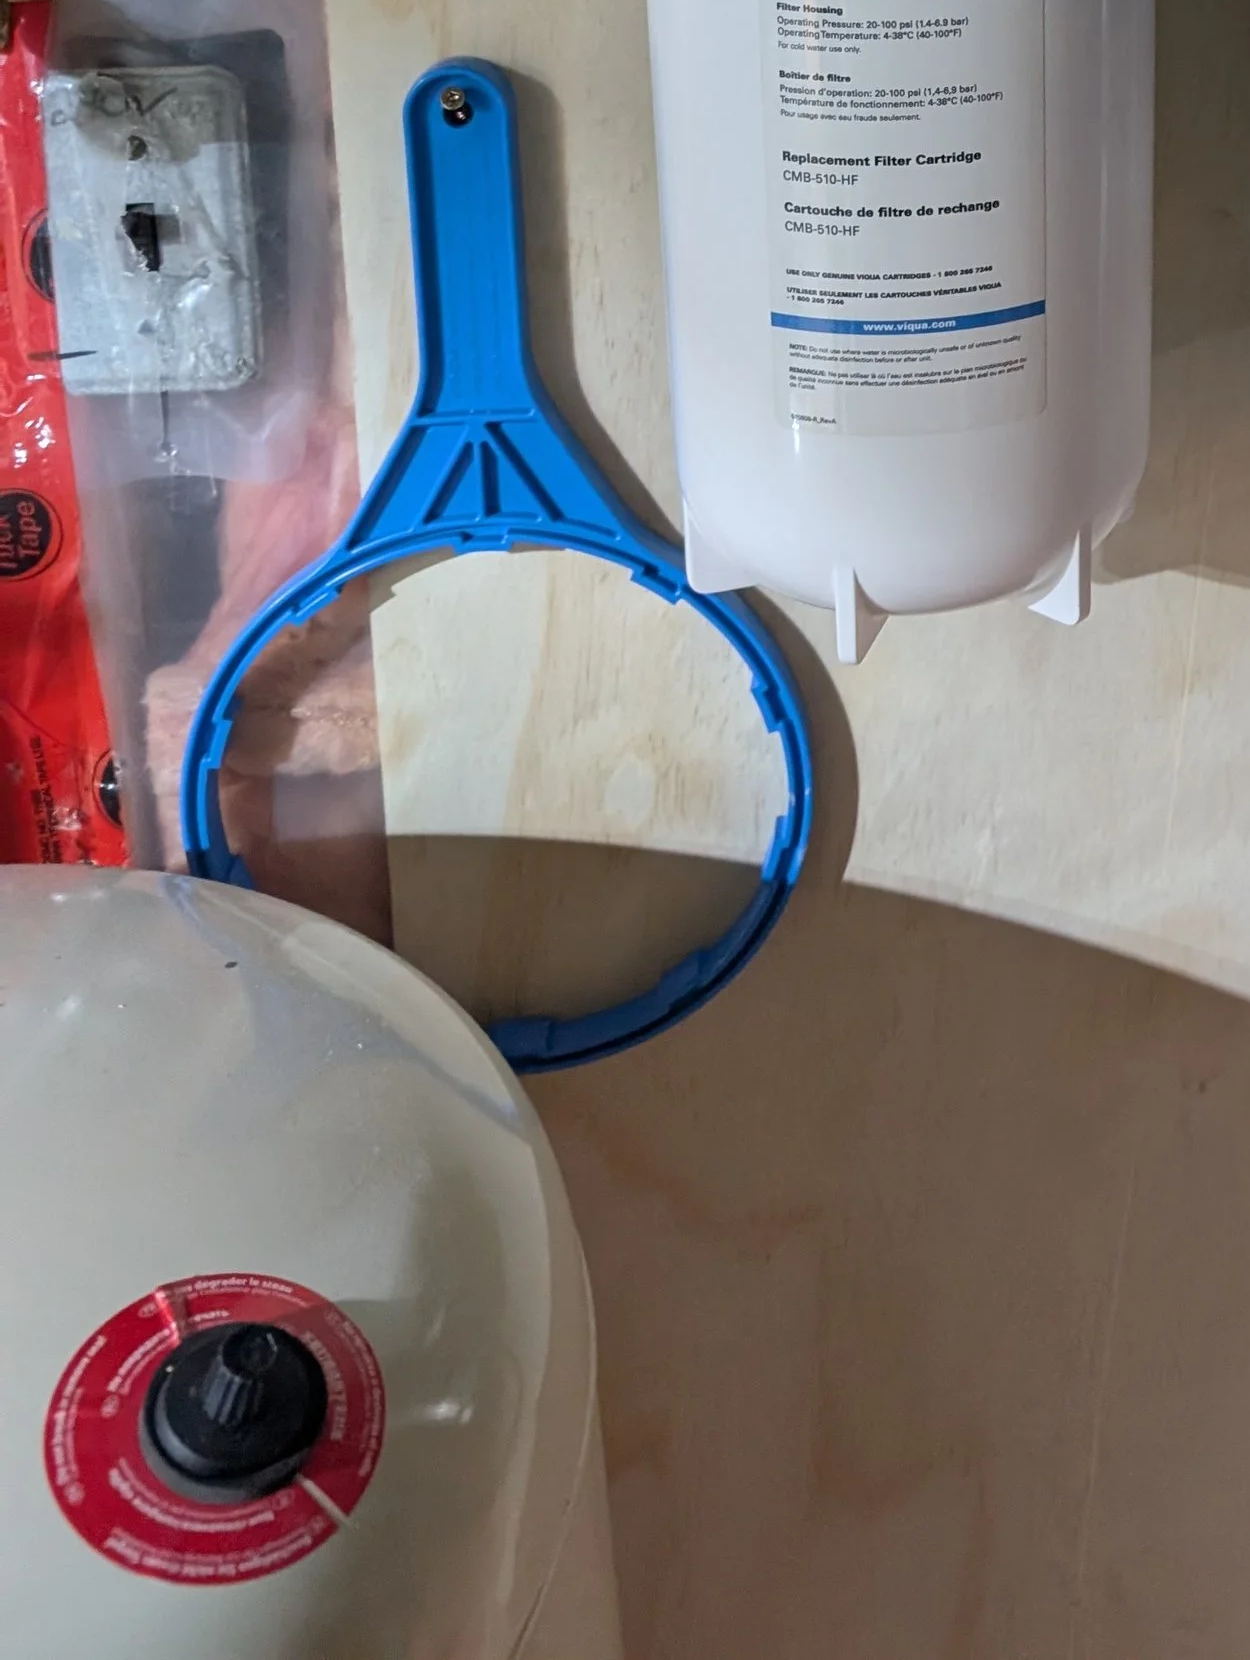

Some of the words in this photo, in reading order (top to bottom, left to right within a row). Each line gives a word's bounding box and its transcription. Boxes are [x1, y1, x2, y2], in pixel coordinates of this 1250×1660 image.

[776, 2, 801, 11] Filter
[803, 4, 843, 16] Housing
[777, 15, 820, 28] Operating
[822, 19, 864, 29] Pressure:
[866, 20, 897, 29] 20-100
[899, 20, 913, 30] psi
[915, 18, 948, 29] (1.4-6.9
[950, 16, 969, 27] bar)
[778, 27, 820, 40] Operating
[820, 30, 881, 41] Temperature:
[883, 31, 914, 40] 4-38°C
[916, 28, 962, 40] (40-100°F)
[778, 41, 789, 49] For
[844, 46, 862, 54] only.
[779, 70, 810, 80] Boîtier
[812, 73, 824, 81] de
[827, 74, 851, 82] filtre
[780, 84, 816, 96] Pression
[875, 89, 905, 97] 20-100
[907, 88, 921, 98] psi
[959, 83, 977, 93] bar)
[780, 95, 834, 107] Température
[837, 100, 848, 108] de
[850, 99, 926, 109] fonctionnement:
[927, 96, 958, 106] 4-38°C
[960, 91, 1003, 105] (40-100°F)
[780, 109, 795, 117] Pour
[797, 112, 818, 120] usage
[880, 114, 921, 122] seulement.
[782, 150, 871, 167] Replacement
[874, 155, 912, 167] Filter
[916, 151, 982, 165] Cartridge
[783, 169, 859, 186] CMB-510-HF
[784, 201, 853, 218] Cartouche
[856, 207, 874, 217] de
[878, 206, 912, 217] filtre
[916, 205, 934, 216] de
[938, 200, 1000, 215] rechange
[785, 220, 860, 236] CMB-510-HF
[786, 268, 800, 276] USE
[801, 270, 820, 278] ONLY
[822, 272, 855, 280] GENUINE
[883, 273, 931, 281] CARTRIDGES
[786, 286, 818, 296] UTILISER
[819, 290, 863, 299] SEULEMENT
[864, 291, 879, 299] LES
[880, 290, 932, 299] CARTOUCHES
[979, 281, 1003, 291] VIQUA
[863, 319, 957, 334] www.viqua.com
[789, 343, 808, 352] NOTE:
[18, 500, 42, 557] Tape
